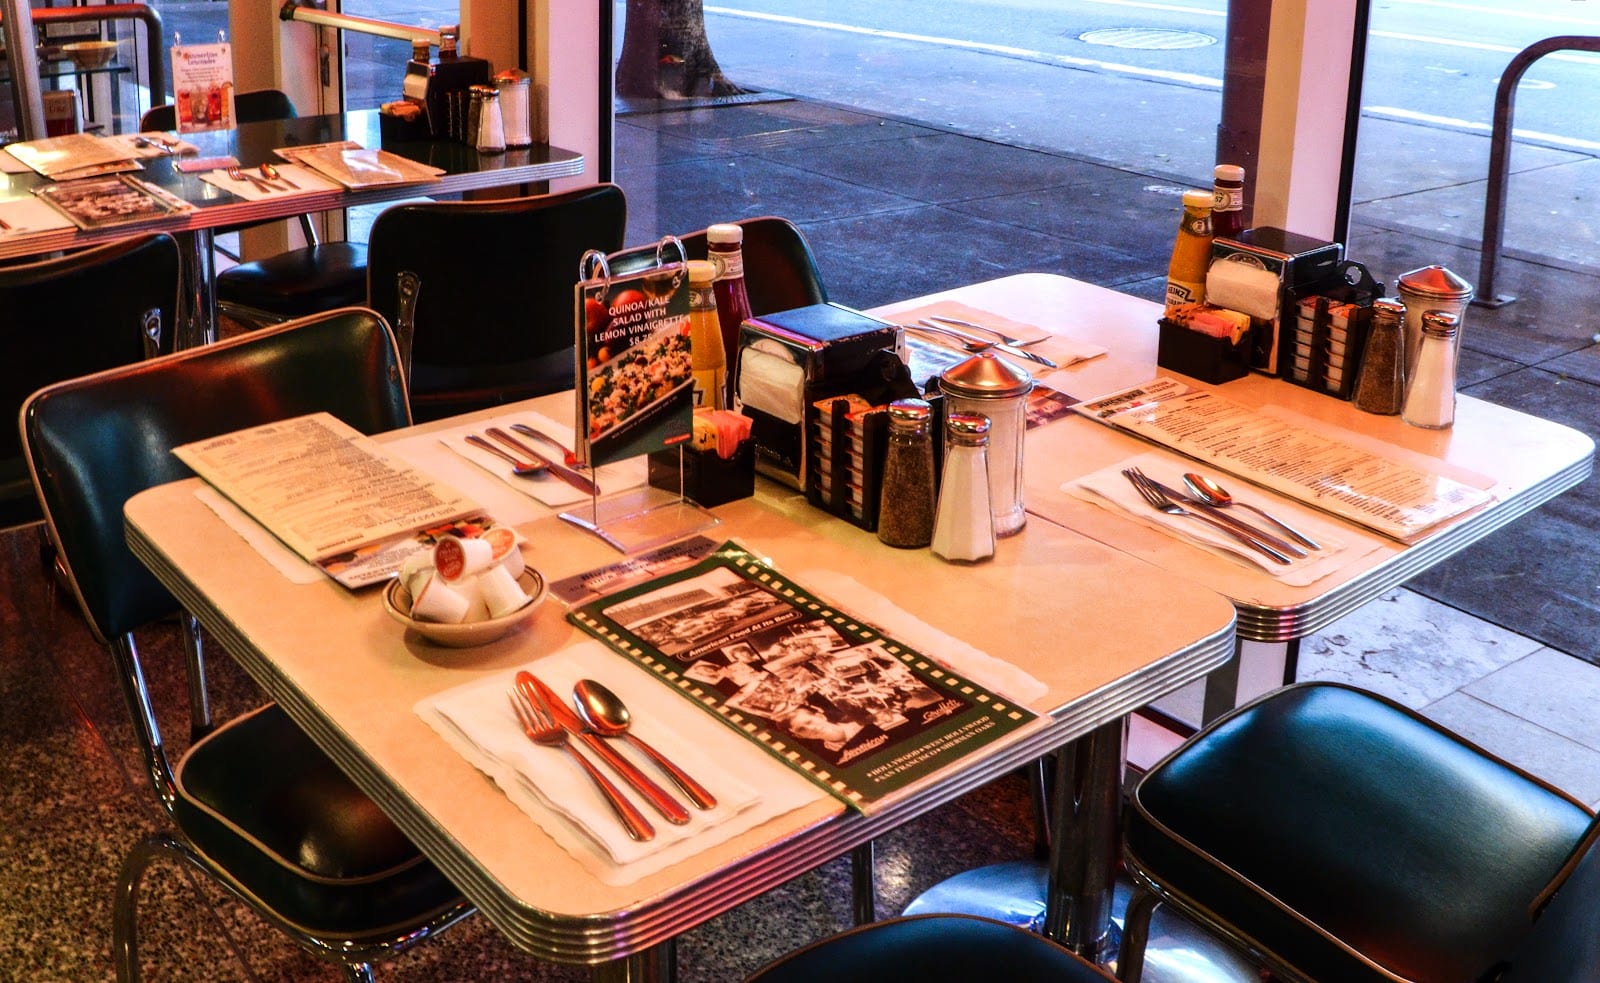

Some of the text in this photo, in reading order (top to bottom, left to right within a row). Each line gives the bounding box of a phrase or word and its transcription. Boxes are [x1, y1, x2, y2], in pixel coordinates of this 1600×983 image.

[609, 295, 670, 316] QUINOA/KALE
[613, 308, 666, 327] SALAD WITH
[595, 315, 682, 342] LEMON VINAIGRETTE
[689, 637, 729, 656] American
[730, 628, 751, 639] Food
[775, 613, 793, 622] Best
[871, 716, 989, 776] HOLLYWOOD WEST HOLLYWOOD
[879, 722, 996, 780] SAN FRANCISCO SHERMAN OAKS
